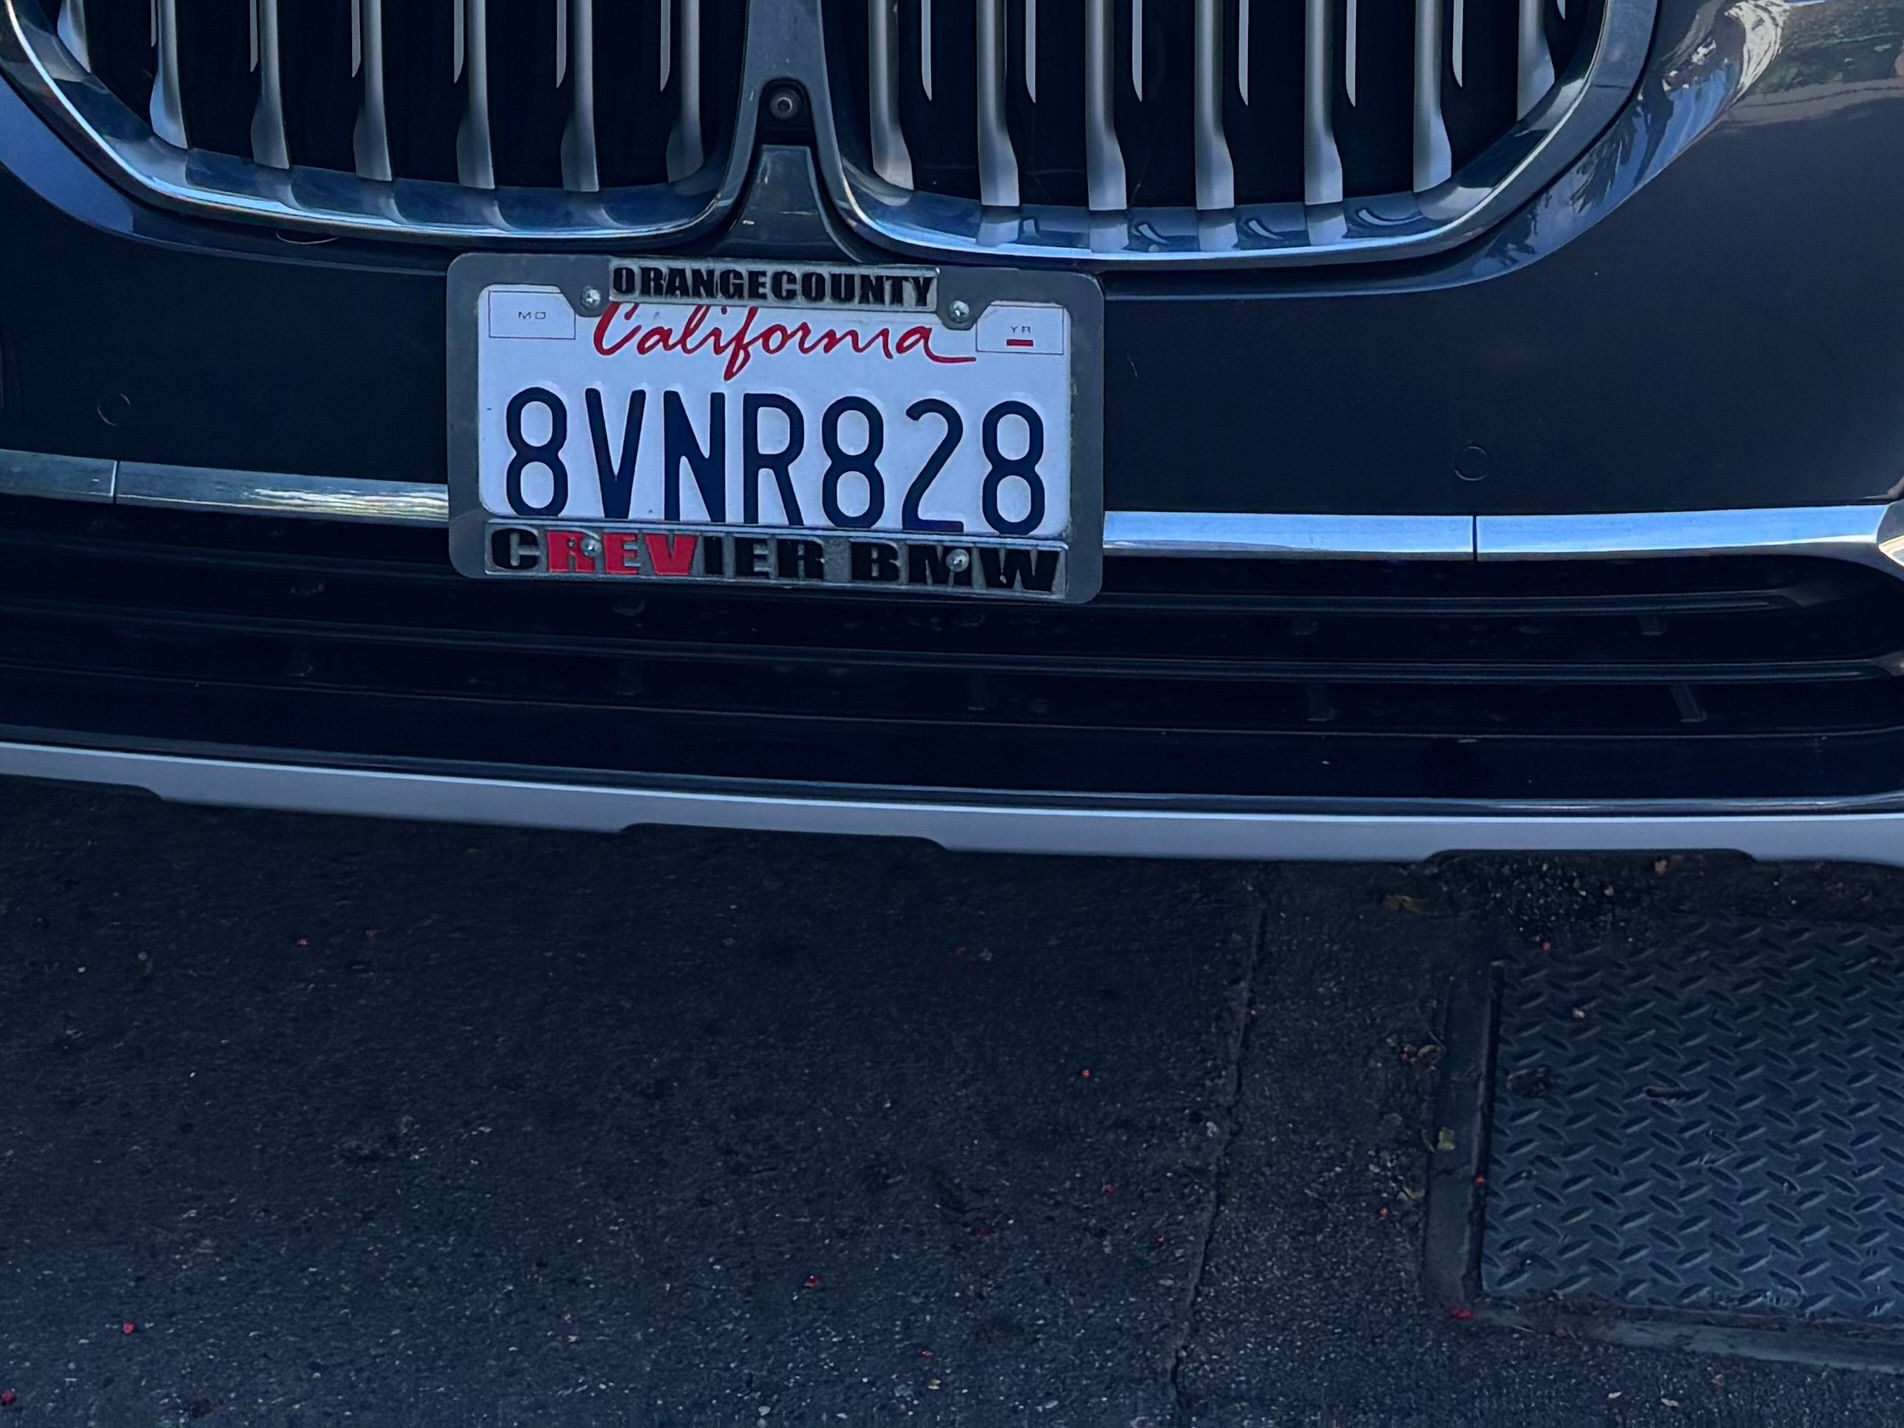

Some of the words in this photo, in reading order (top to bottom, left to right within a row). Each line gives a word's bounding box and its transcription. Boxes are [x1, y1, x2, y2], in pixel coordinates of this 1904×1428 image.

[517, 311, 547, 320] MO
[593, 301, 977, 382] California
[1009, 325, 1032, 334] YR
[505, 386, 1045, 536] 8VNR828
[490, 527, 825, 580] CREVIER
[849, 540, 1060, 592] BMW
